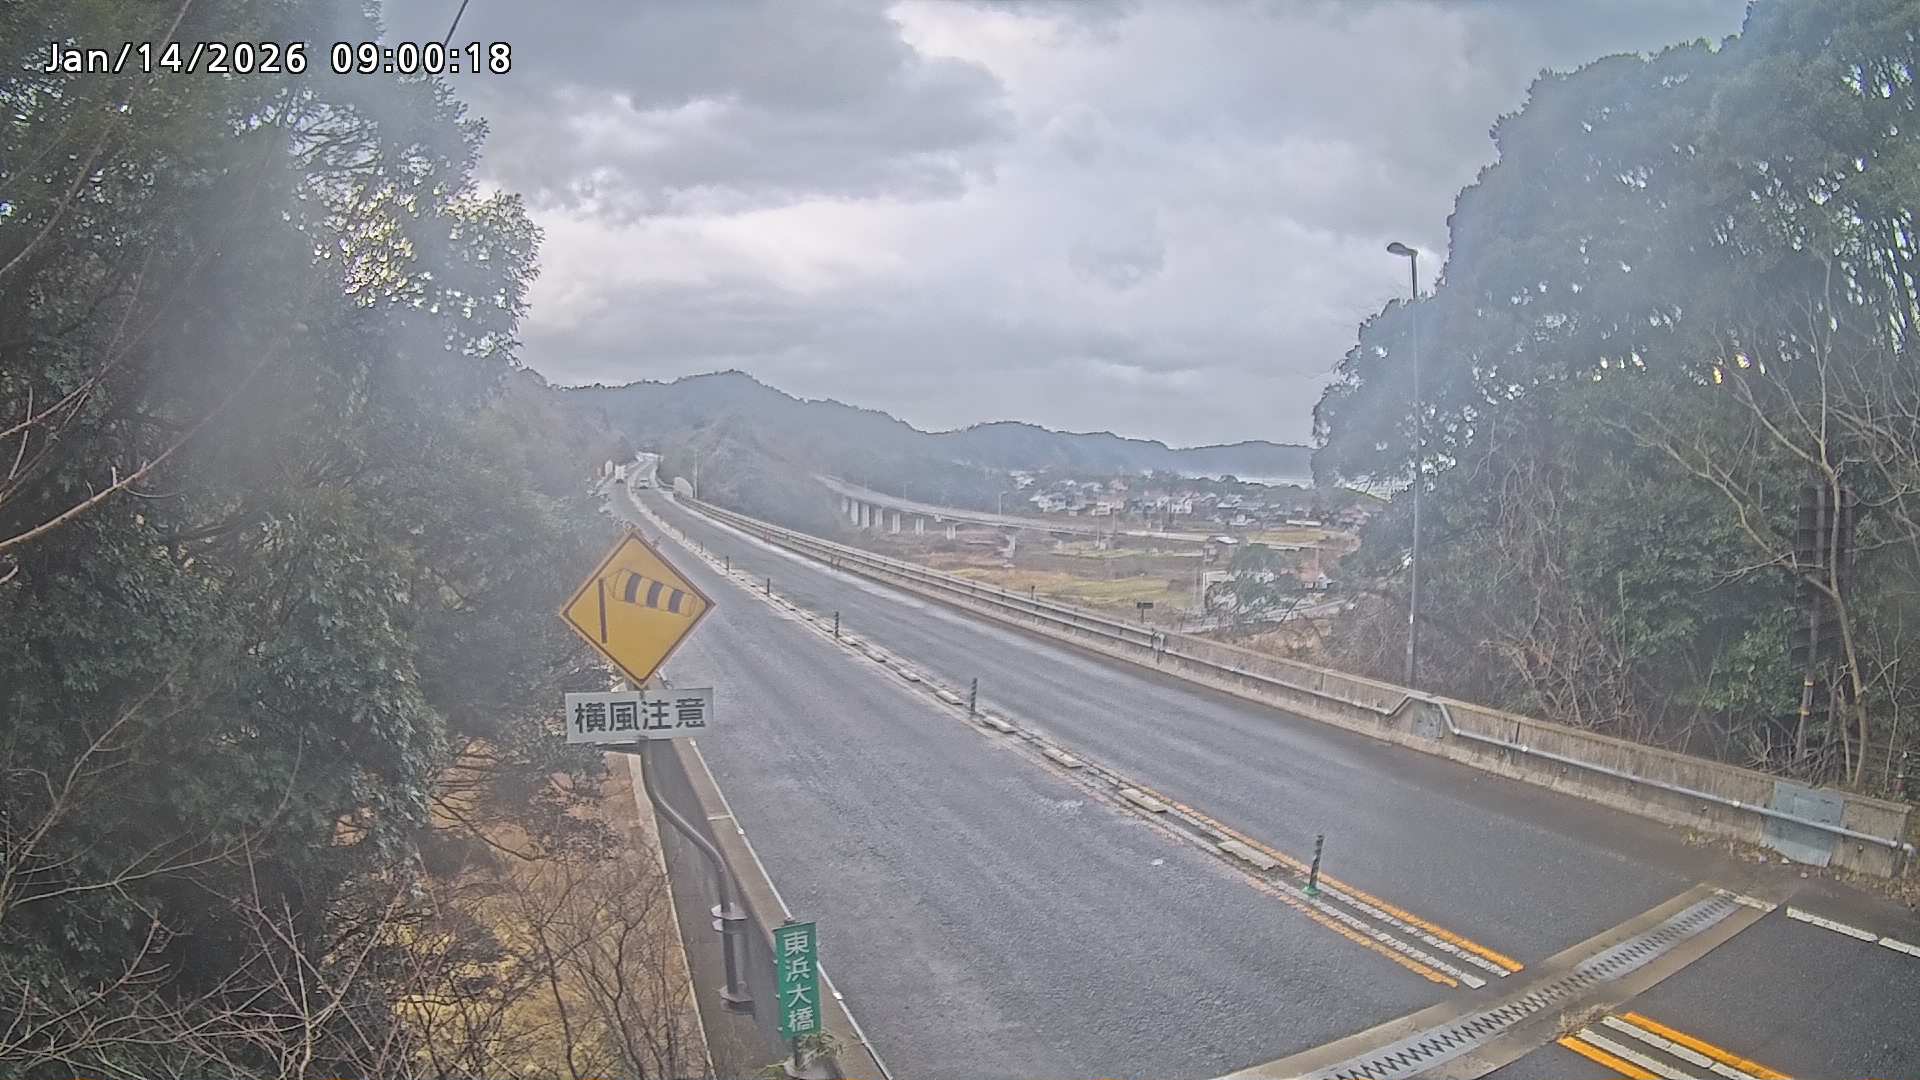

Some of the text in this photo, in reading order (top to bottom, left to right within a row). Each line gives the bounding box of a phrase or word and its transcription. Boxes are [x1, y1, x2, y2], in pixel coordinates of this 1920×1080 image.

[574, 697, 706, 734] 横風注意
[782, 930, 815, 1033] 東浜大橋
